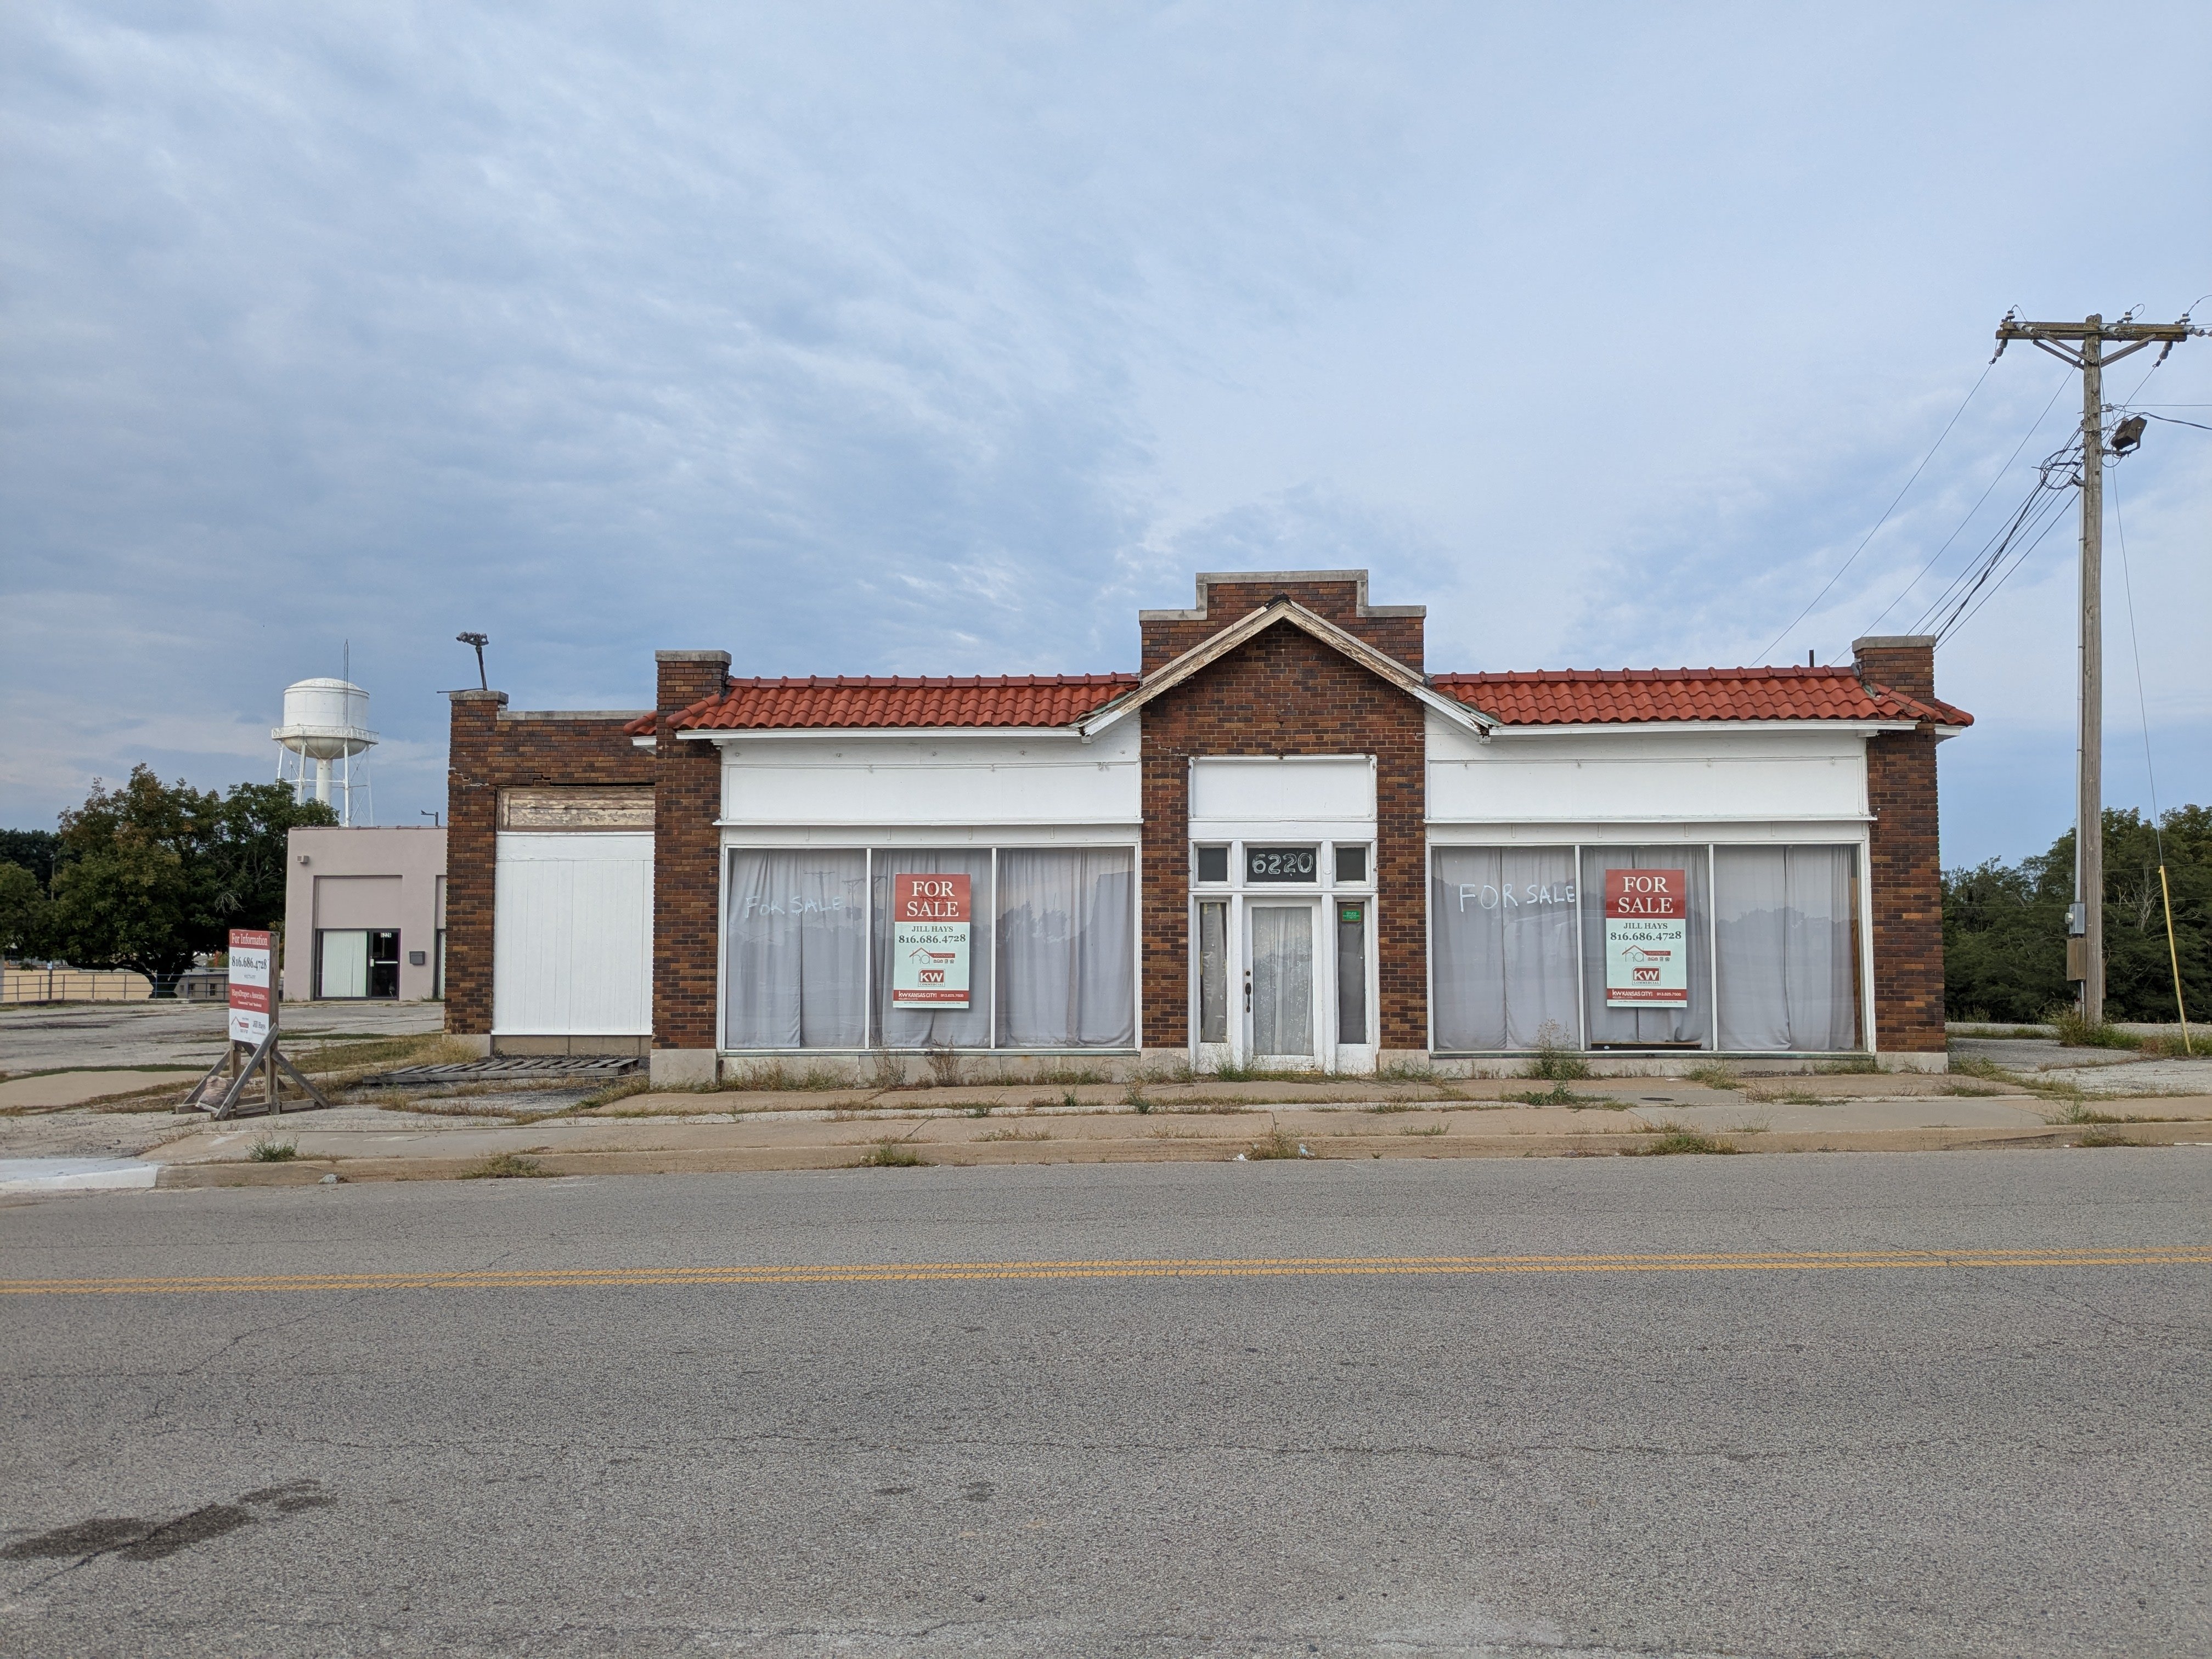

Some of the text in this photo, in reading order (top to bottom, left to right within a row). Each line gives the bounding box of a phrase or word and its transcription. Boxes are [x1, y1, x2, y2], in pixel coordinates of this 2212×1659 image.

[1252, 853, 1313, 874] 6220
[912, 881, 955, 896] FOR
[1622, 876, 1669, 893] FOR
[1459, 883, 1576, 912] FOR SALE
[1618, 897, 1673, 913] SALE
[790, 895, 843, 916] SALE
[907, 901, 959, 917] SALE
[232, 933, 268, 946] For Information
[899, 934, 966, 944] 816.686.4728
[1610, 931, 1681, 941] 816.686.4728
[232, 956, 267, 971] 816.686.4728
[920, 972, 943, 982] KW
[1634, 970, 1658, 980] KW
